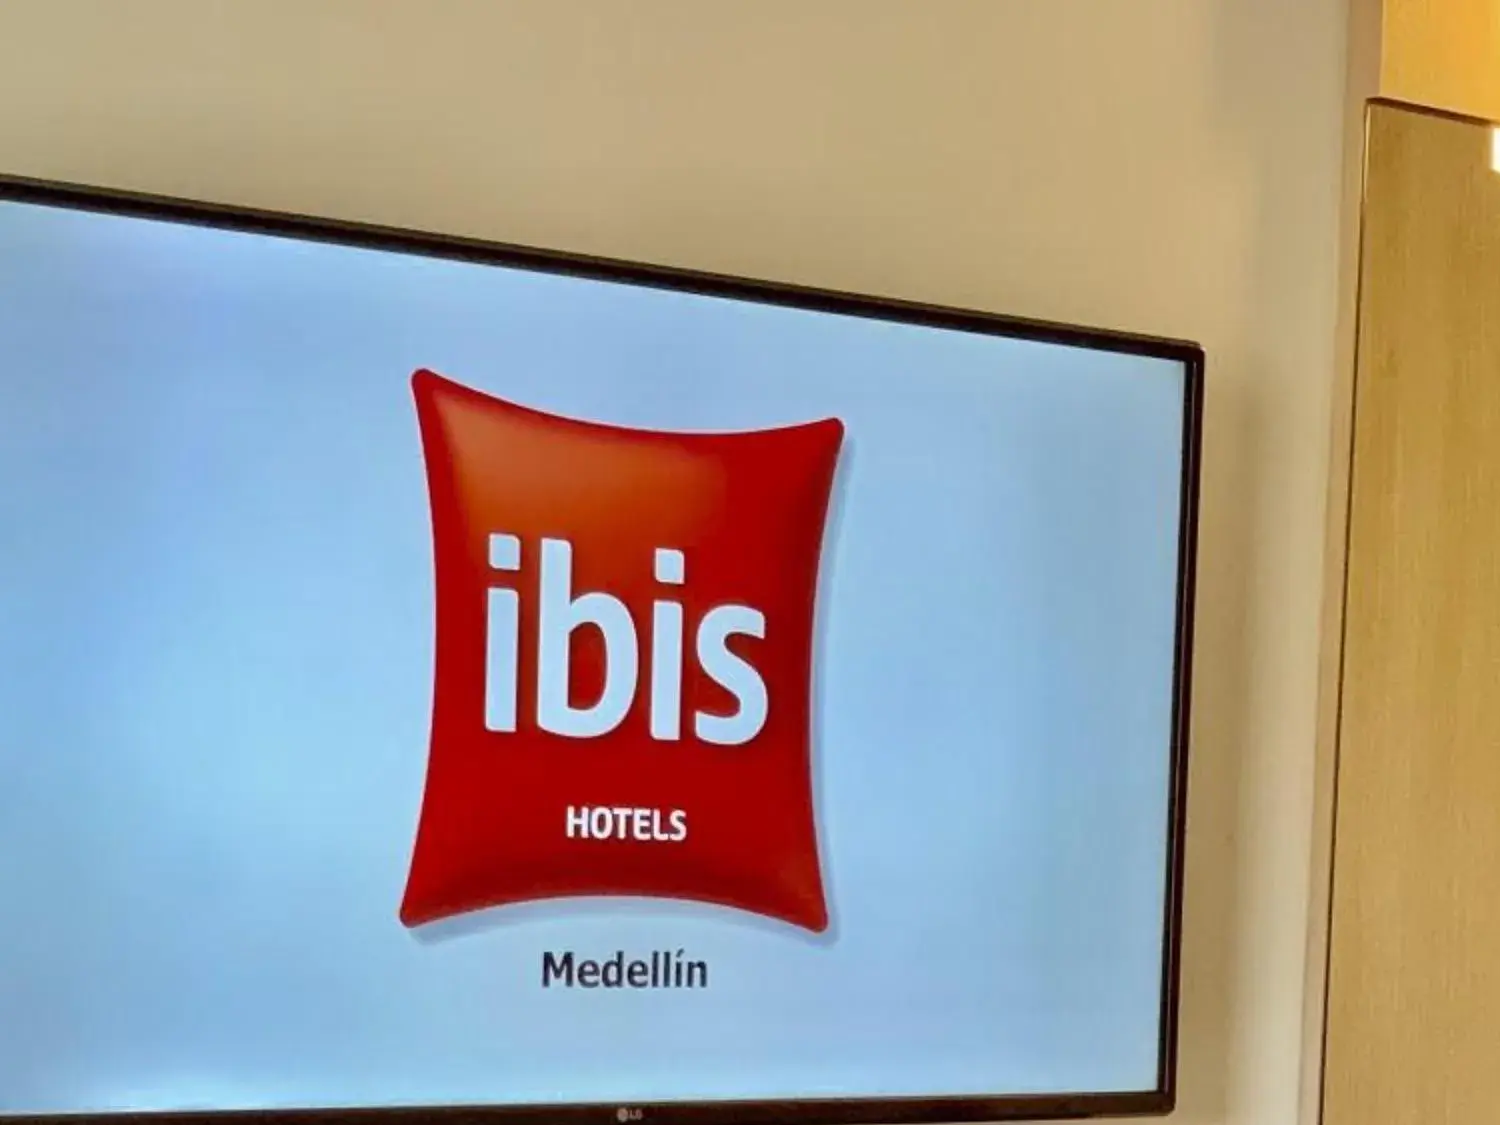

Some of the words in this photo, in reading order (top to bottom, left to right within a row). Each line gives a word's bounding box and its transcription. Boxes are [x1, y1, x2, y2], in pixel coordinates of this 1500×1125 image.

[484, 532, 769, 746] ibis
[565, 806, 688, 842] HOTELS
[541, 949, 709, 989] Medellín
